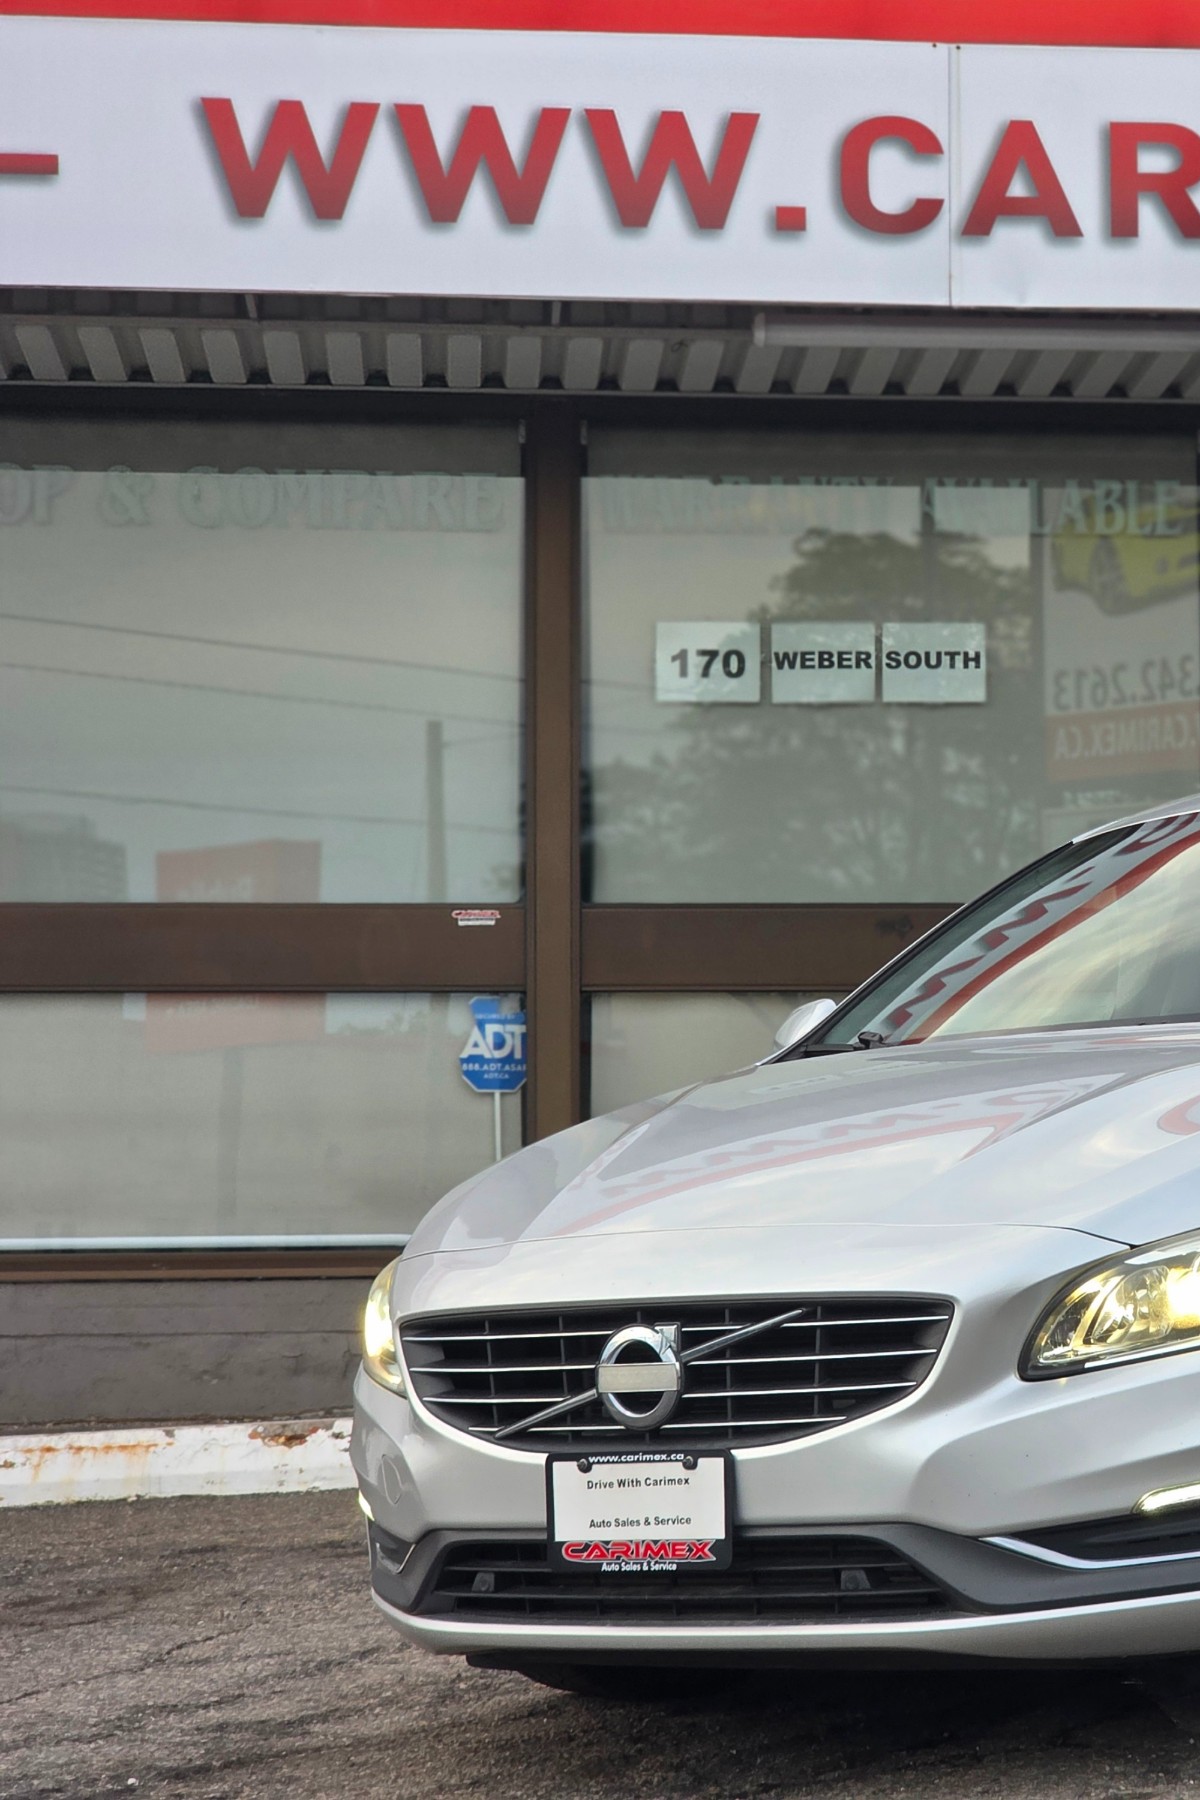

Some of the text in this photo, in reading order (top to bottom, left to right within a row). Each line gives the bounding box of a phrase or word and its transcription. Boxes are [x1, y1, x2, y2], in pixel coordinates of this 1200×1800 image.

[670, 649, 982, 679] 170 WEBER SOUTH
[459, 1023, 527, 1060] ADT
[588, 1452, 685, 1464] www.carimex.ca
[587, 1475, 690, 1490] Drive With Carimex
[589, 1515, 692, 1529] Auto Sales & Service
[561, 1540, 717, 1563] CARIMEX
[601, 1560, 677, 1572] Auto Sales & Service
